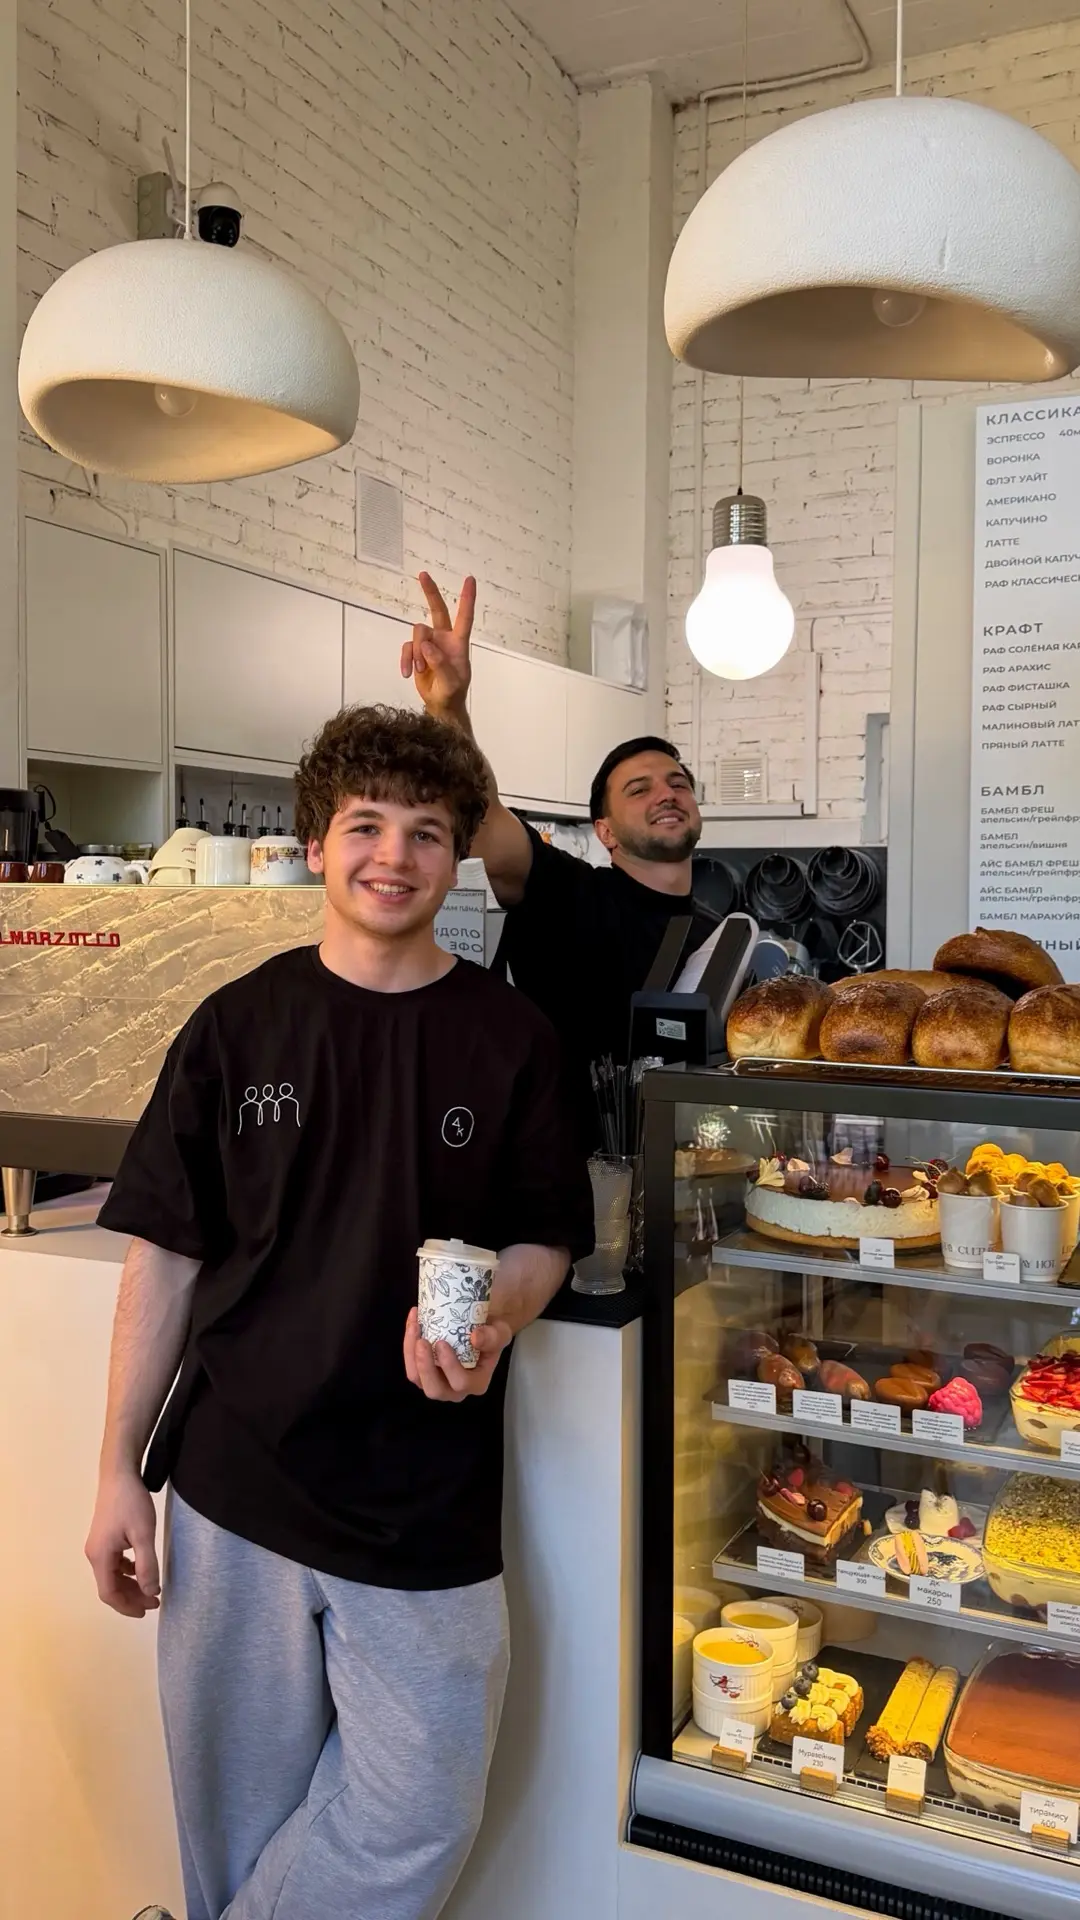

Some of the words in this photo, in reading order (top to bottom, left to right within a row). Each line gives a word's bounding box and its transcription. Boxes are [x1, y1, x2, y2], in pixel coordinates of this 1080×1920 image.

[986, 406, 1080, 425] КЛАССИКА
[987, 431, 1045, 444] ЭСПРЕССО
[987, 453, 1040, 465] ВОРОНКА
[986, 476, 1016, 486] ФЛЭТ
[1019, 472, 1048, 483] УАЙТ
[986, 493, 1056, 506] АМЕРИКАНО
[986, 514, 1047, 527] КАПУЧИНО
[985, 537, 1019, 548] ЛАТТЕ
[984, 556, 1042, 569] ДВОЙНОЙ
[985, 578, 1008, 588] РАФ
[983, 622, 1043, 637] КРАФТ
[983, 646, 1006, 655] РАФ
[1008, 643, 1060, 654] СОЛЁНАЯ
[983, 666, 1006, 674] РАФ
[1008, 663, 1051, 673] АРАХИС
[983, 685, 1006, 693] РАФ
[1008, 681, 1070, 692] ФИСТАШКА
[982, 703, 1005, 712] РАФ
[1007, 700, 1057, 711] СЫРНЫЙ
[982, 719, 1055, 731] МАЛИНОВЫЙ
[1057, 719, 1080, 728] ЛАТ
[981, 740, 1028, 750] ПРЯНЫЙ
[1031, 739, 1065, 748] ЛАТТЕ
[981, 784, 1045, 797] БАМБЛ
[981, 806, 1019, 815] БАМБЛ
[1021, 806, 1054, 814] ФРЕШ
[980, 815, 1080, 824] апельсин/грейпфр
[980, 833, 1018, 841] БАМБЛ
[980, 841, 1067, 850] апельсин/вишня
[980, 859, 1002, 868] АЙС
[1005, 860, 1043, 868] БАМБЛ
[1045, 859, 1079, 867] ФРЕШ
[980, 868, 1080, 878] апельсин/грейпфр
[980, 885, 1002, 894] АЙС
[1005, 886, 1042, 894] БАМБЛ
[980, 894, 1080, 903] апельсин/грейпфр
[980, 912, 1017, 921] БАМБЛ
[1020, 911, 1080, 921] МАРАКУЙЯ
[929, 1579, 941, 1587] ДК
[926, 1596, 942, 1606] 250
[813, 1743, 824, 1751] ДК
[1029, 1806, 1069, 1824] тирамису
[1040, 1818, 1057, 1829] 400
